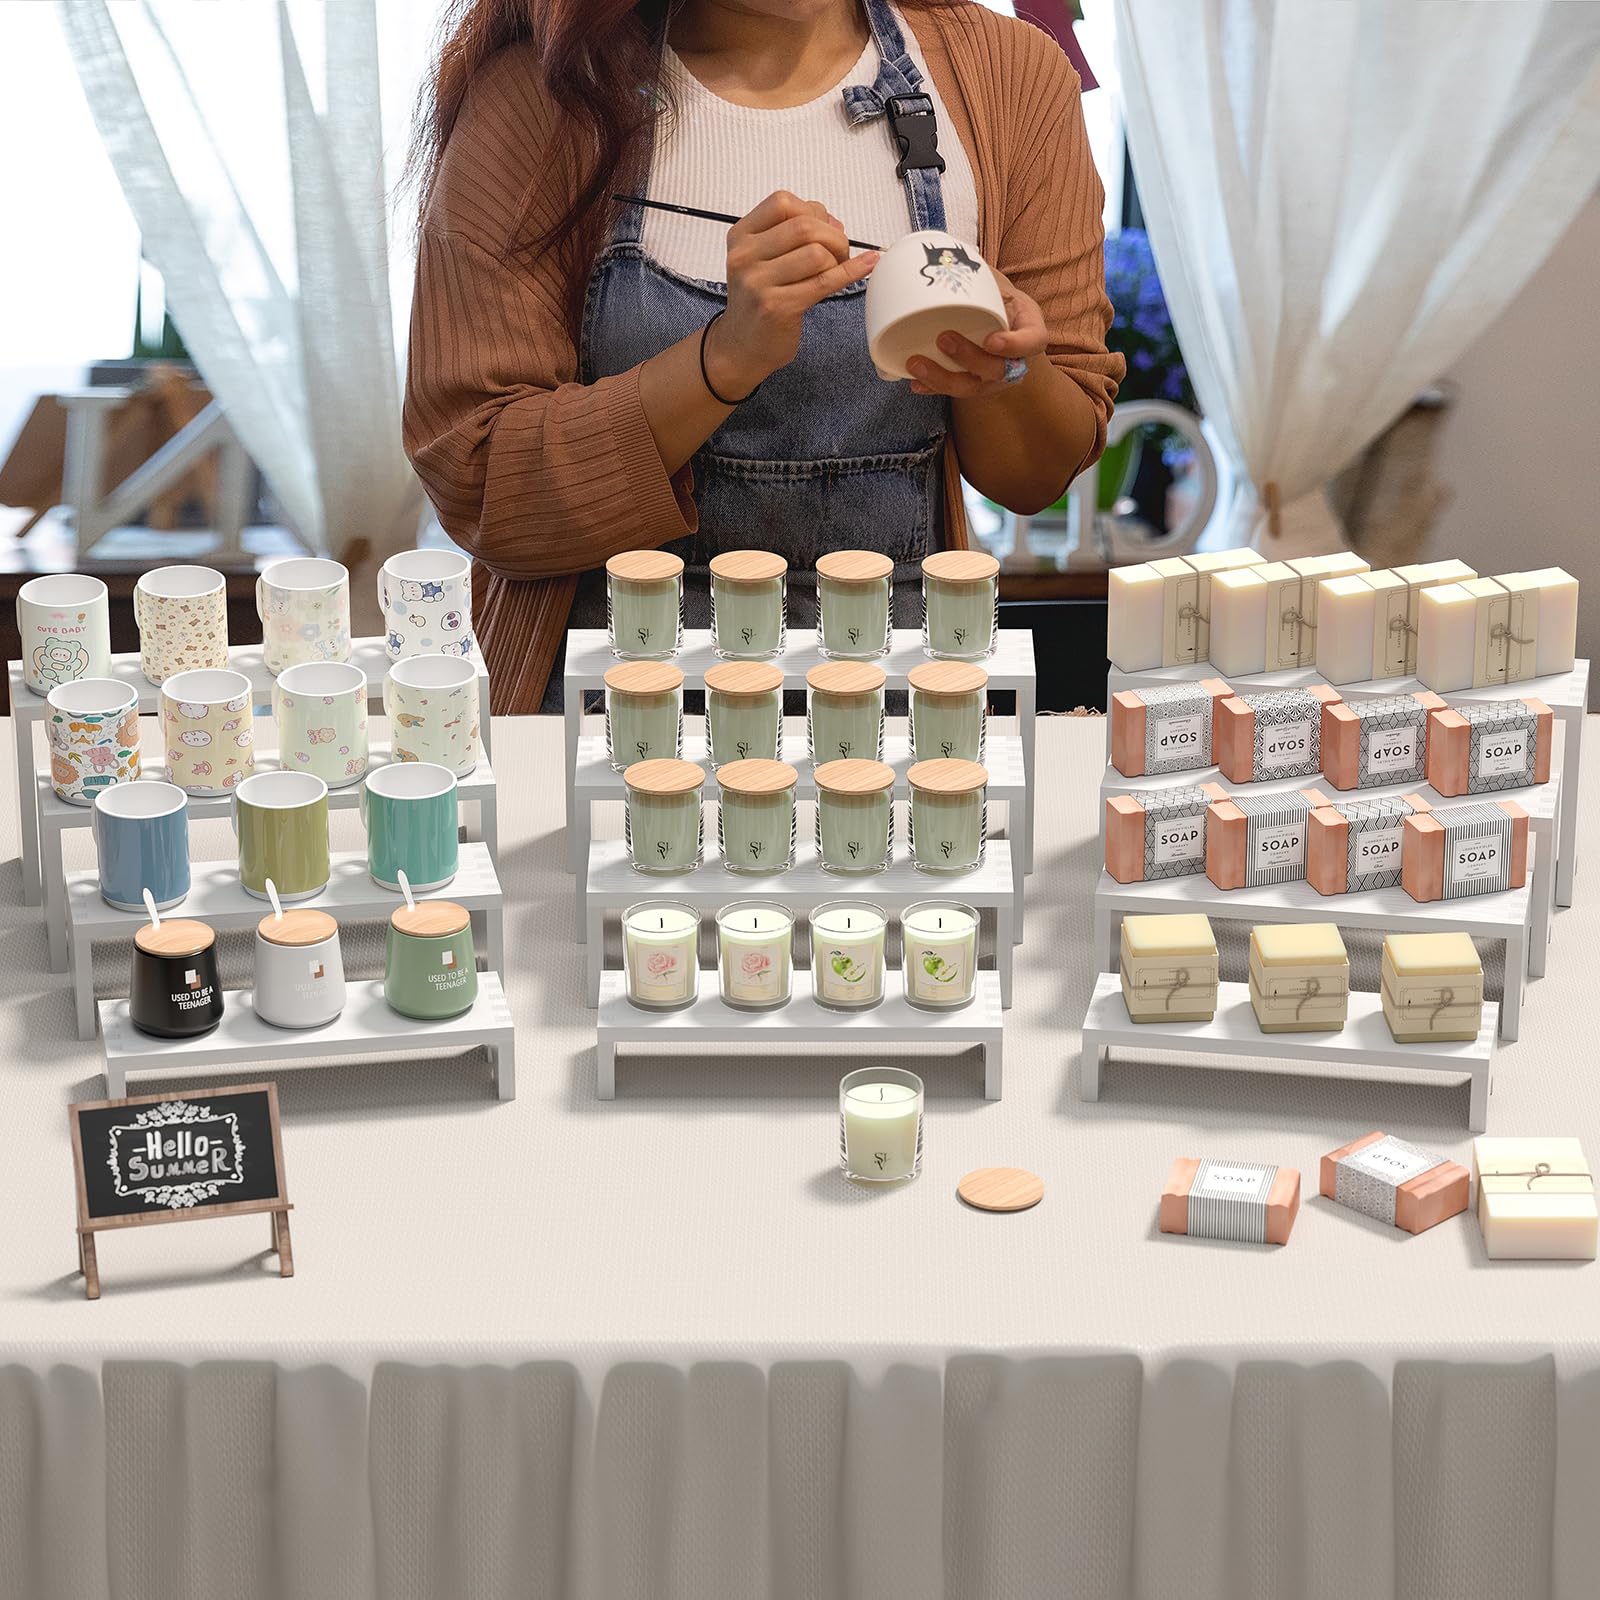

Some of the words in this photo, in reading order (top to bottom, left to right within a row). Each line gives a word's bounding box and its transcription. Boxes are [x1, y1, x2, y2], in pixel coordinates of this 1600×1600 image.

[1160, 732, 1197, 746] SOAP
[1268, 738, 1305, 753] SOAP
[1374, 744, 1410, 759] SOAP
[1485, 744, 1522, 759] SOAP
[1161, 830, 1198, 845] SOAP
[1261, 837, 1299, 852] SOAP
[1362, 842, 1399, 856] SOAP
[1459, 849, 1496, 864] SOAP
[428, 974, 446, 983] USED
[457, 970, 464, 978] BE
[435, 976, 467, 991] TEENAGER
[171, 993, 190, 1002] USED
[191, 991, 200, 999] TO
[201, 989, 209, 997] BE
[178, 995, 212, 1010] TEENAGER
[146, 1131, 208, 1160] Hello
[1372, 1153, 1408, 1170] SOAP
[1213, 1174, 1256, 1184] SOAP
